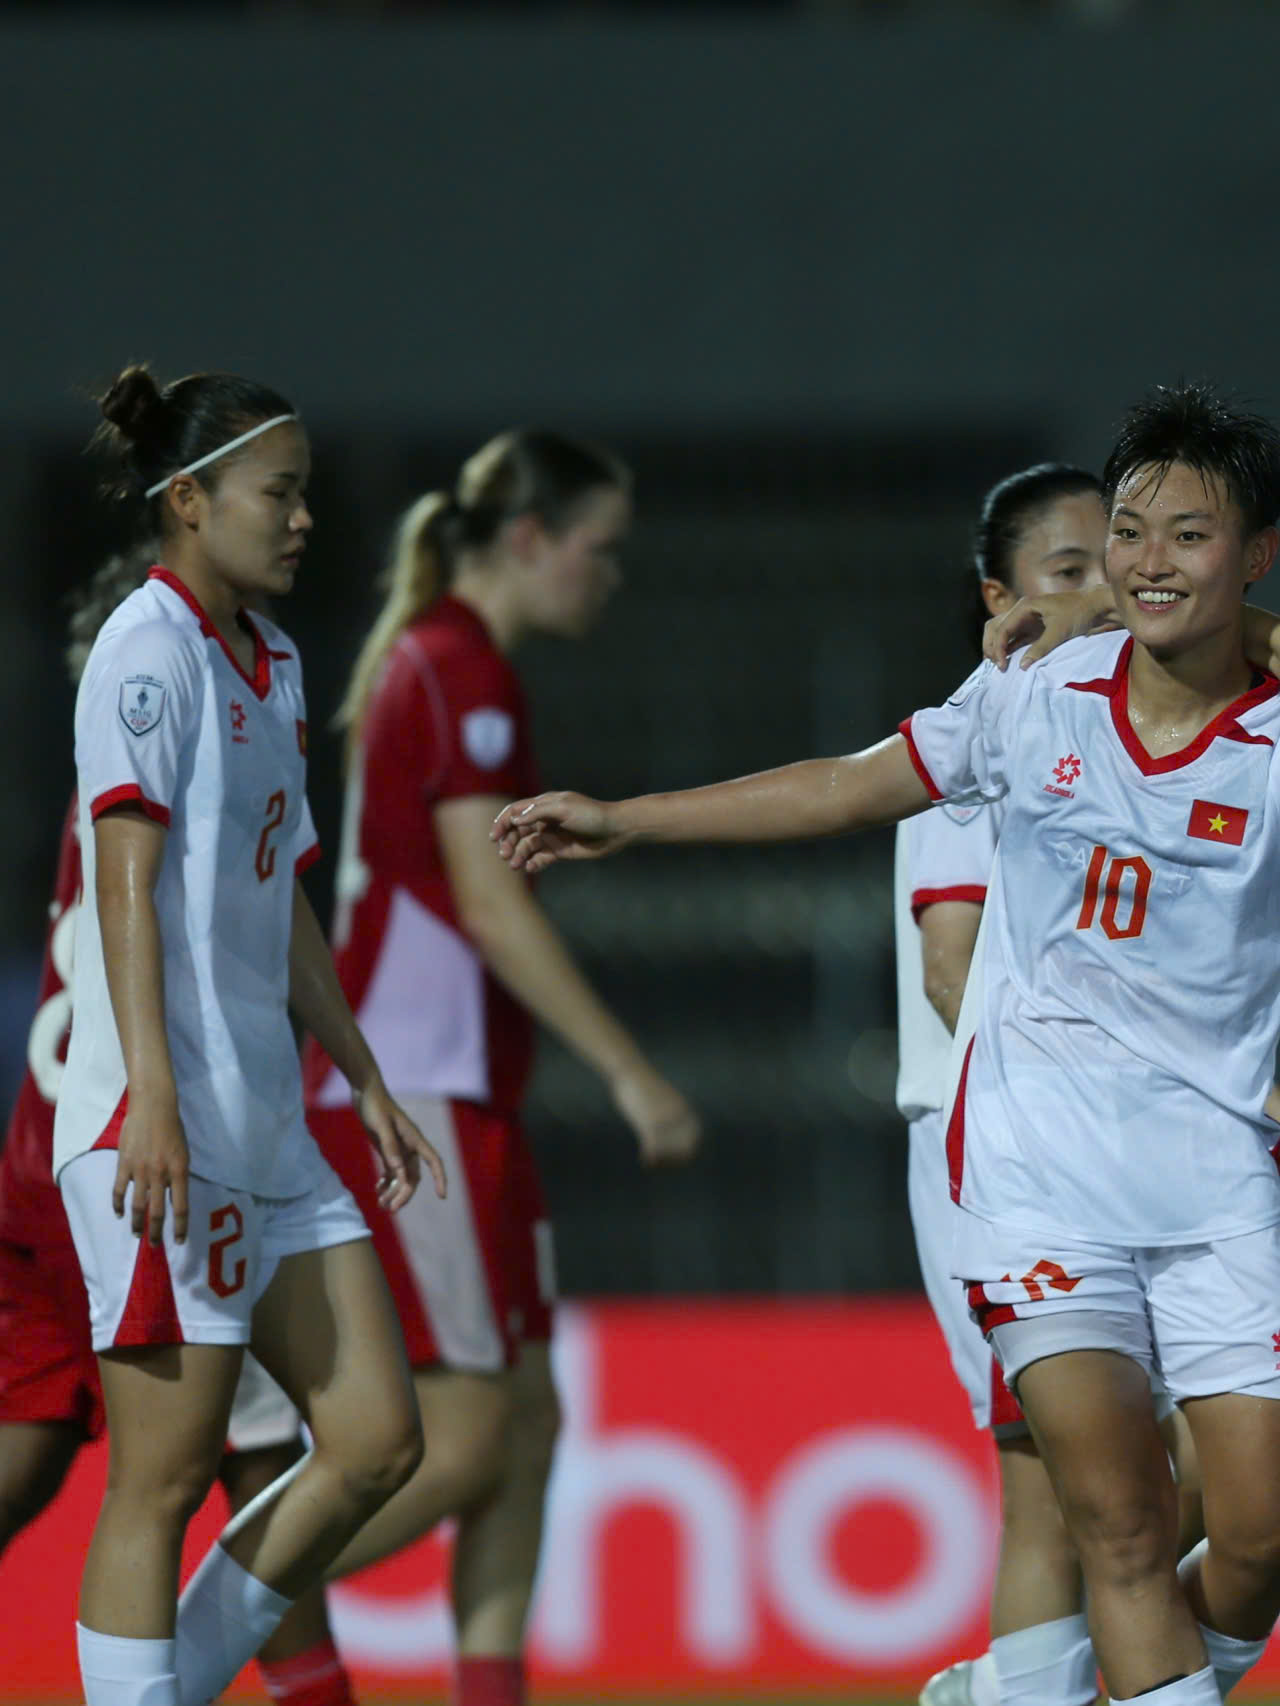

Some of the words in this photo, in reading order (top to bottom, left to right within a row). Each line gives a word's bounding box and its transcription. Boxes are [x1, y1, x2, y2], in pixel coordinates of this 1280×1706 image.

[255, 788, 287, 884] 2
[1075, 844, 1153, 940] 10
[208, 1202, 248, 1299] 2
